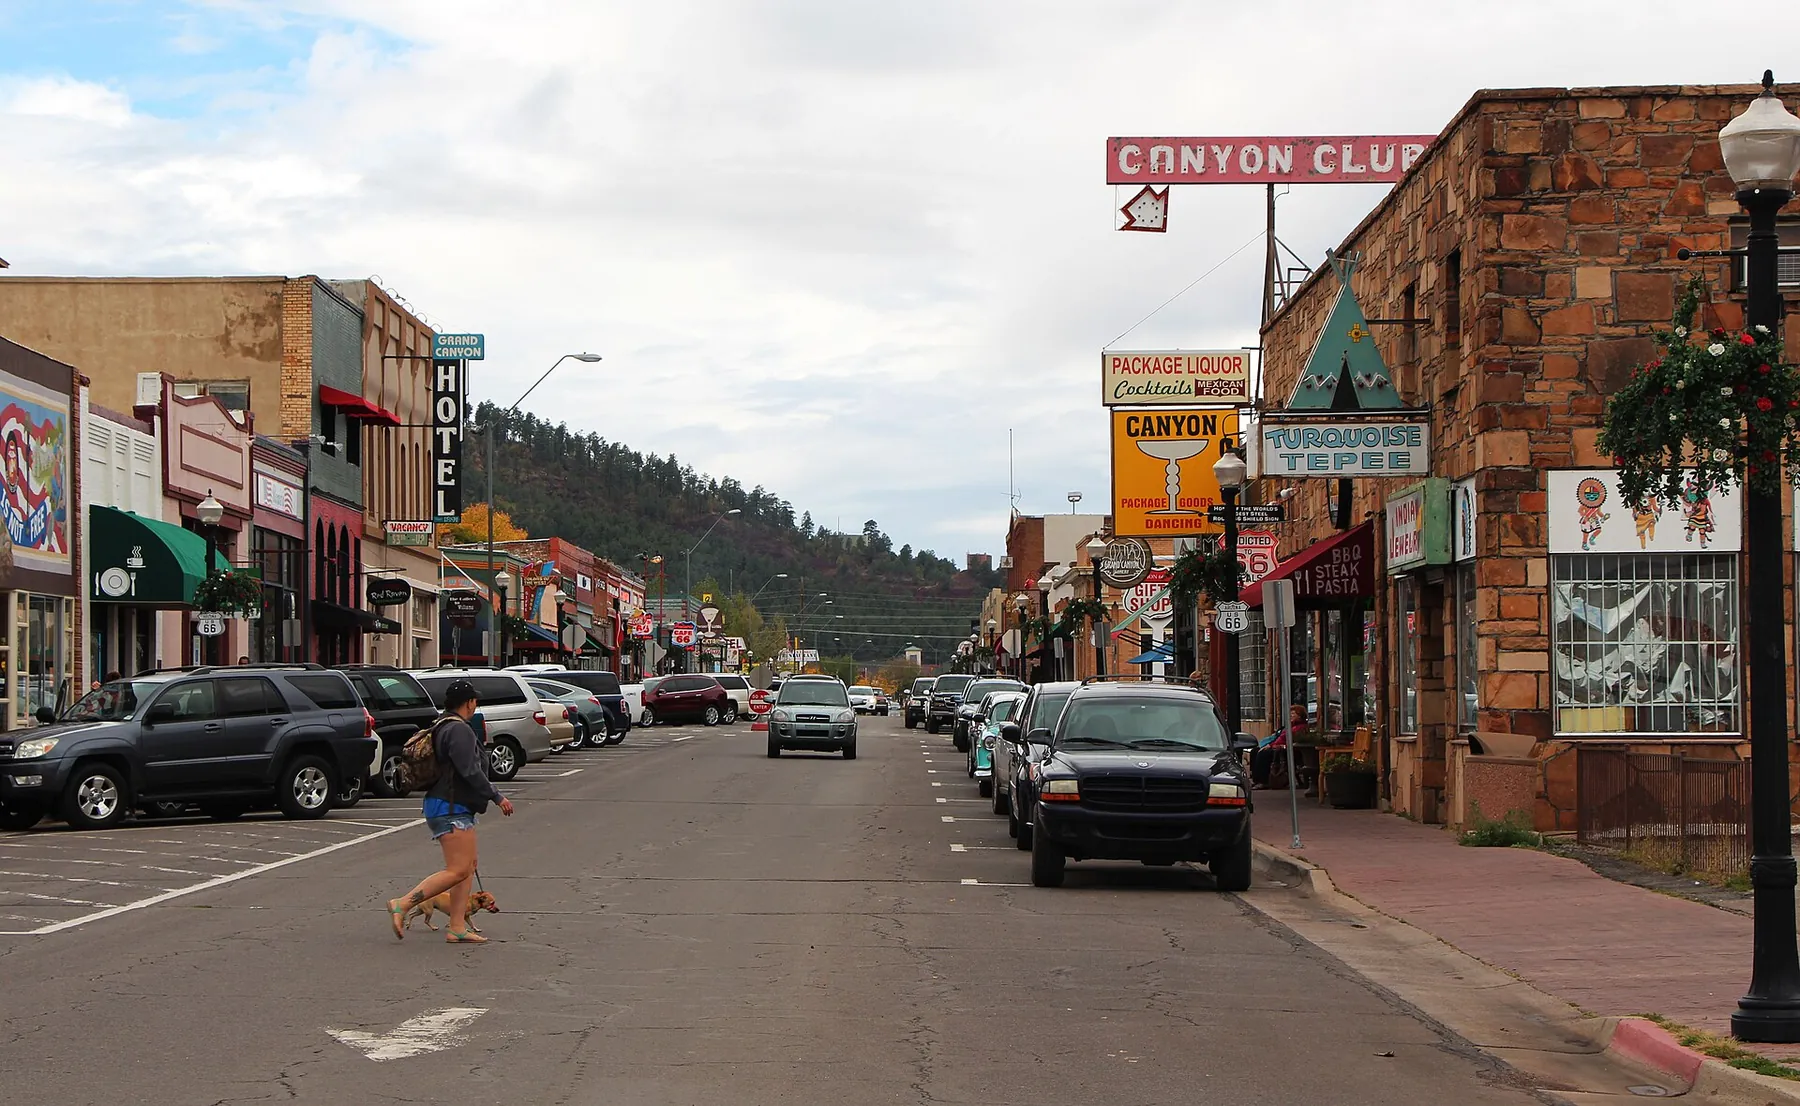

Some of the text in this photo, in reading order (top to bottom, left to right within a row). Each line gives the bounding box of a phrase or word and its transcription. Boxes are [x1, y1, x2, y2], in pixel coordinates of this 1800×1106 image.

[1118, 144, 1293, 174] CANYON
[437, 335, 479, 346] GRAND
[435, 347, 481, 357] CANYON
[1112, 356, 1242, 375] PACKAGE LIQUOR
[1113, 379, 1244, 399] Cocktails MEXICAN
[1203, 387, 1240, 396] FOOD
[1126, 414, 1217, 437] CANYON
[436, 365, 457, 517] HOTEL
[1264, 425, 1422, 450] TURQUOISE
[1279, 451, 1411, 471] TEPEE
[1121, 497, 1214, 508] PACKAGE GOODS
[1, 488, 45, 544] IS NOT FREE
[390, 522, 429, 532] VACANCY
[1145, 519, 1202, 529] DANCING
[1238, 537, 1271, 545] DICTED
[1332, 544, 1362, 564] BBQ
[1120, 558, 1140, 569] CANYON
[1315, 561, 1360, 579] STEAK
[1134, 583, 1167, 597] GIFT
[1316, 577, 1359, 596] PASTA
[370, 590, 385, 600] Red
[1130, 597, 1171, 612] SHOP
[203, 623, 216, 633] 66
[1225, 617, 1241, 629] 66
[676, 635, 690, 644] 66
